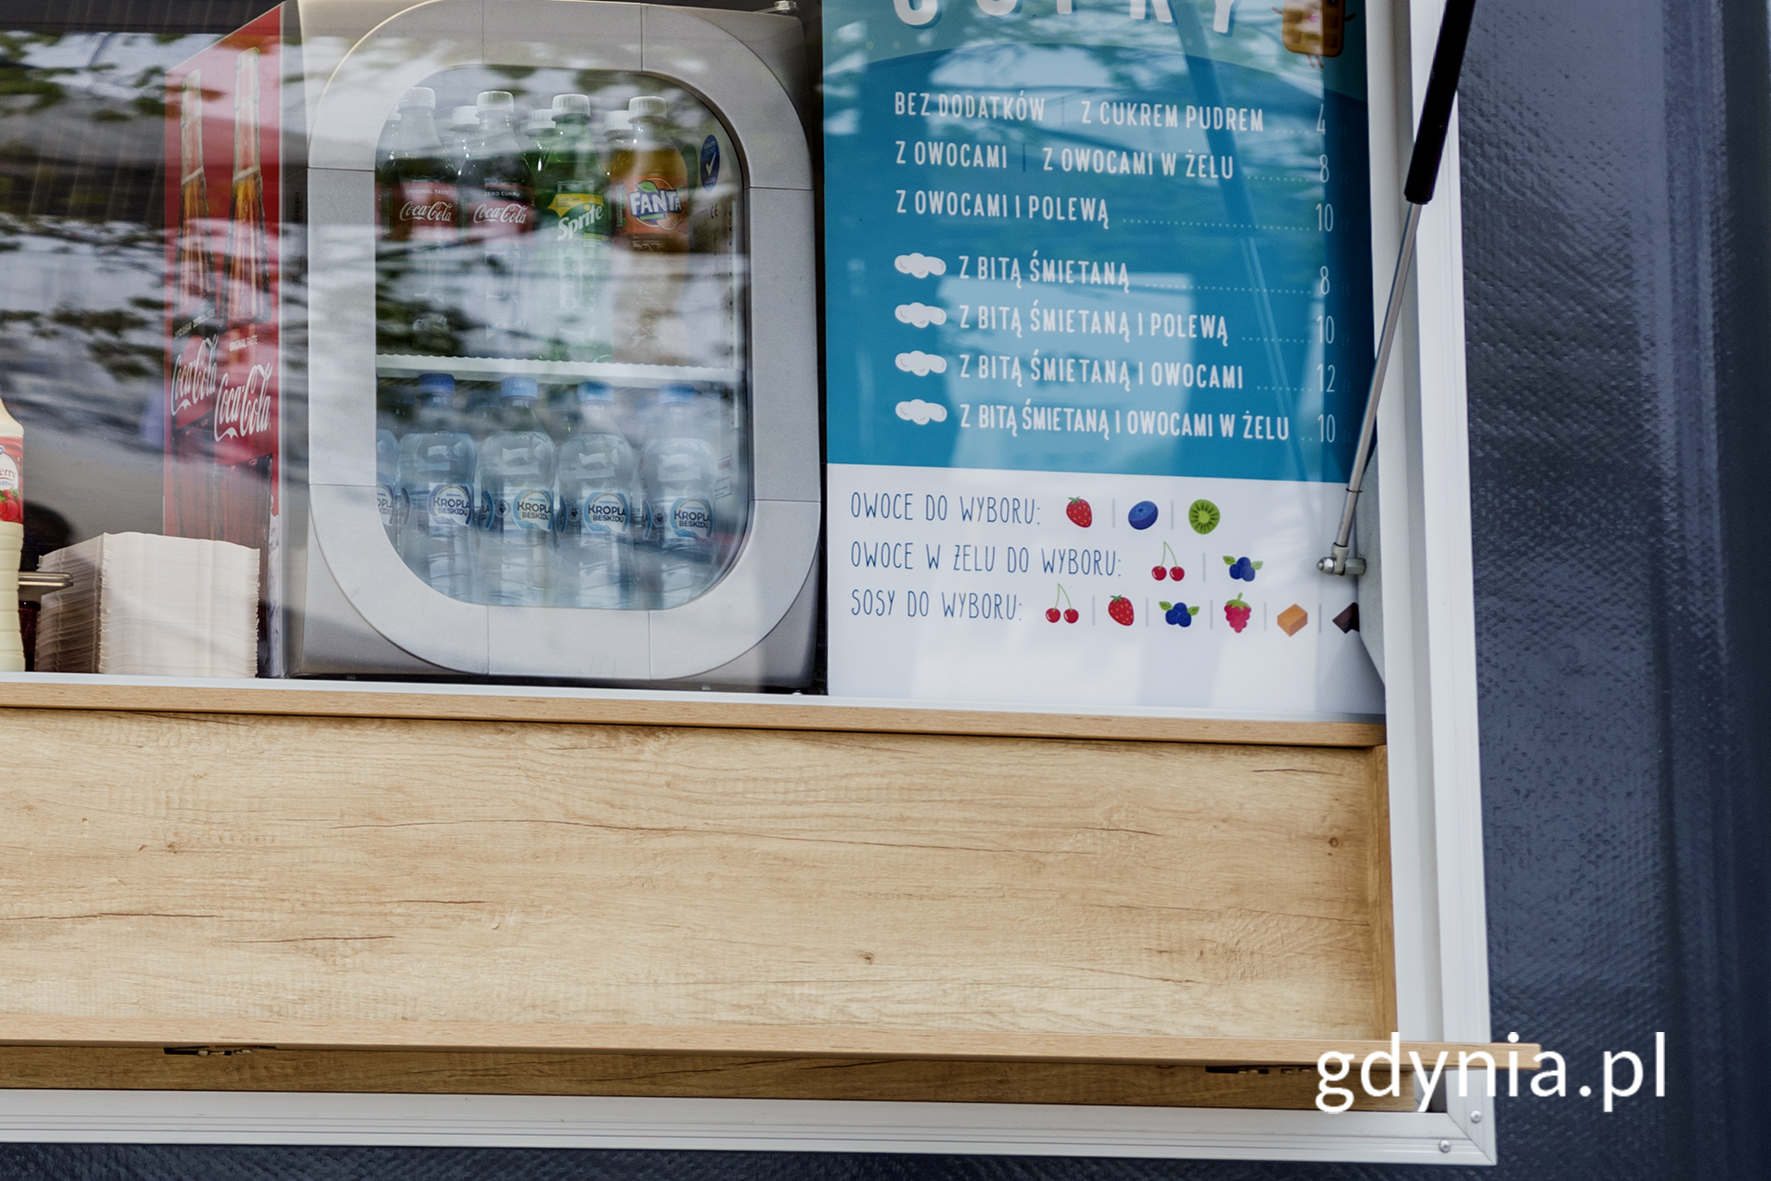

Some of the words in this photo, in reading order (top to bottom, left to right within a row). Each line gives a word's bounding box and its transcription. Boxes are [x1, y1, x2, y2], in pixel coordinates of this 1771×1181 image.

[894, 91, 930, 116] BEZ
[938, 89, 1046, 121] DODATKÓW
[1081, 100, 1091, 124] Z
[1099, 101, 1178, 127] CUKREM
[1186, 105, 1264, 132] PUDREM
[1316, 103, 1326, 135] 4
[895, 140, 906, 164] Z
[914, 141, 1007, 169] OWOCAMI
[1042, 147, 1053, 171] Z
[1061, 148, 1153, 175] OWOCAMI
[1161, 152, 1177, 176] W
[1185, 149, 1234, 179] ŻELU
[1319, 154, 1329, 183] 8
[629, 190, 682, 216] FANTA
[896, 189, 907, 213] Z
[914, 190, 1008, 218] OWOCAMI
[1015, 195, 1021, 218] I
[1029, 195, 1109, 230] POLEWĄ
[1316, 203, 1334, 232] 10
[557, 205, 604, 241] Sprite
[959, 255, 970, 279] Z
[978, 256, 1022, 289] BITĄ
[1030, 249, 1130, 293] ŚMIETANĄ
[1320, 266, 1330, 295] 8
[959, 304, 970, 328] Z
[978, 305, 1022, 338] BITĄ
[1030, 299, 1130, 343] ŚMIETANĄ
[1138, 312, 1143, 336] I
[1150, 312, 1228, 347] POLEWĄ
[1317, 315, 1335, 343] 10
[960, 354, 970, 378] Z
[979, 355, 1023, 388] BITĄ
[1030, 348, 1130, 392] ŚMIETANĄ
[1138, 361, 1143, 385] I
[1151, 362, 1243, 389] OWOCAMI
[1317, 364, 1335, 393] 12
[214, 362, 273, 442] Coca-Cola
[960, 404, 971, 428] Z
[978, 404, 1018, 437] BITĄ
[1022, 398, 1110, 441] ŚMIETANĄ
[1115, 410, 1120, 433] I
[1127, 410, 1213, 437] OWOCAMI
[1220, 413, 1235, 438] W
[1242, 410, 1289, 441] ŻELU
[1318, 414, 1336, 443] 10
[433, 497, 470, 509] KROPLA
[517, 501, 552, 514] KROPLA
[588, 504, 626, 515] KROPLA
[674, 510, 710, 522] KROPLA
[851, 491, 914, 521] OWOCE
[925, 494, 948, 521] DO
[959, 496, 1041, 525] WYBORU:
[851, 541, 914, 570] OWOCE
[926, 543, 941, 569] W
[953, 545, 995, 572] ŻELU
[1007, 546, 1029, 574] DO
[1041, 547, 1122, 577] WYBORU:
[851, 588, 895, 616] SOSY
[907, 590, 929, 618] DO
[941, 592, 1022, 621] WYBORU:
